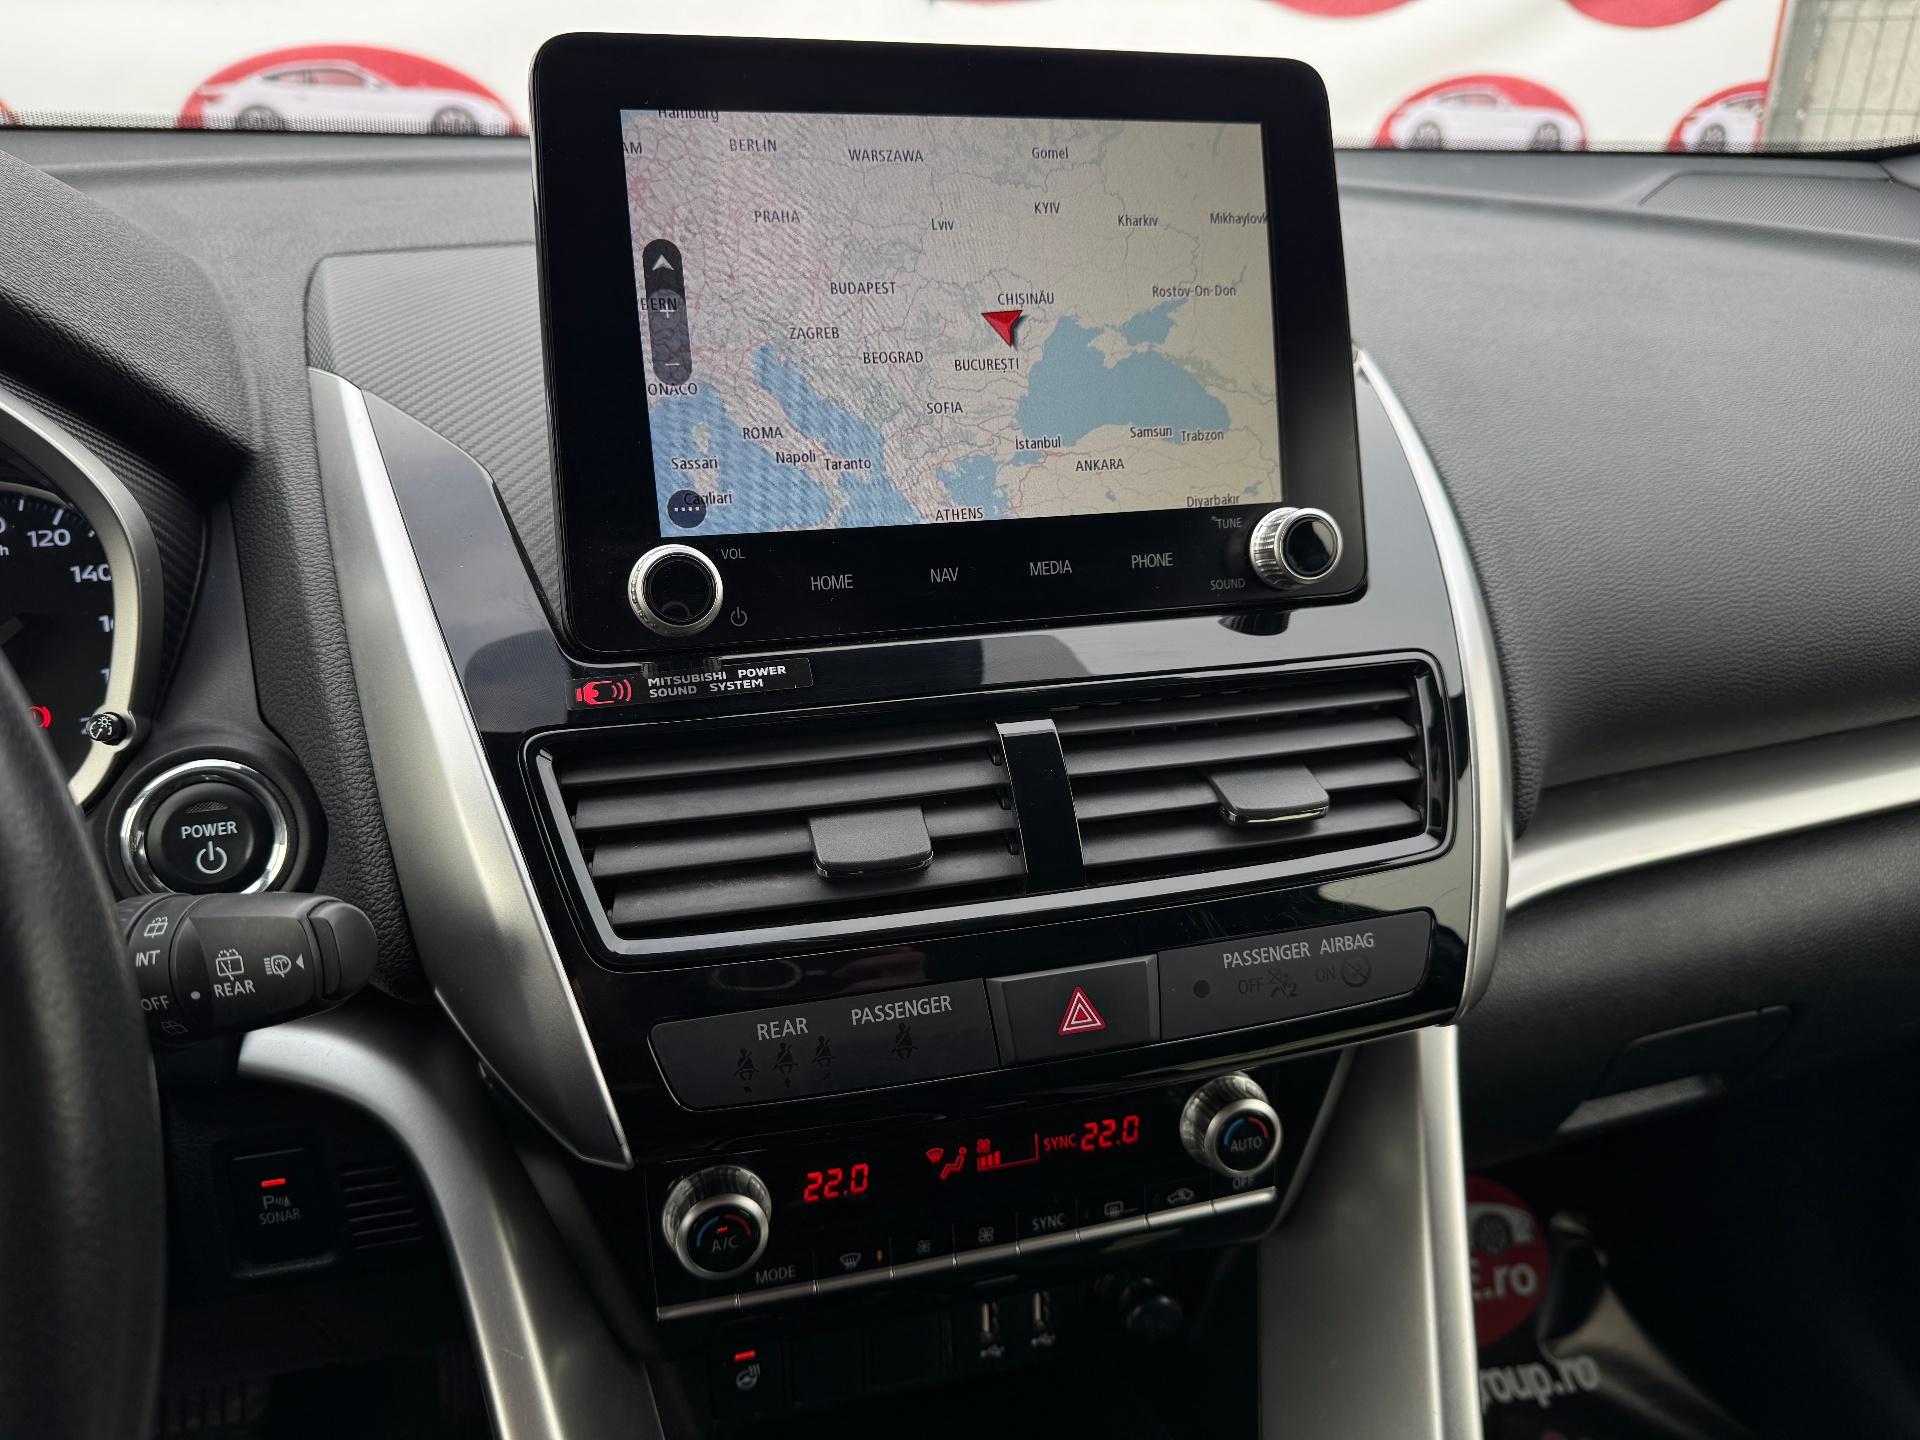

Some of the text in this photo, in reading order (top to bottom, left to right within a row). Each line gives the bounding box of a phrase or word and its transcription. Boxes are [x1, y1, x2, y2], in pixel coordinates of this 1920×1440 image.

[729, 138, 777, 152] BERLIN
[849, 149, 924, 163] WARSZAWA
[1031, 146, 1069, 160] Gomel
[1034, 201, 1060, 215] KYIV
[754, 209, 800, 223] PRAHA
[1117, 214, 1158, 227] Kharkiv
[931, 217, 954, 231] Lviv
[830, 281, 896, 296] BUDAPEST
[1152, 284, 1237, 299] Rostov-On-Don
[640, 297, 677, 311] BERN
[789, 326, 840, 340] ZAGREB
[862, 350, 923, 365] BEOGRAD
[926, 402, 963, 415] SOFIA
[742, 427, 783, 440] ROMA
[1129, 427, 1173, 439] Samsun
[1180, 429, 1225, 442] Trabzon
[671, 456, 719, 470] Sassari
[775, 451, 817, 465] Napoli
[824, 458, 872, 471] Taranto
[1075, 458, 1126, 472] ANKARA
[684, 491, 733, 507] Cagliari
[935, 507, 984, 522] ATHENS
[1215, 517, 1243, 529] TUNE
[27, 528, 72, 549] 120
[721, 548, 746, 560] VOL
[1131, 552, 1174, 569] PHONE
[930, 567, 959, 584] NAV
[1029, 559, 1073, 577] MEDIA
[811, 574, 854, 592] HOME
[1210, 578, 1246, 591] SOUND
[647, 665, 787, 688] MITSUBISHI POWER
[649, 678, 764, 699] SOUND SYSTEM
[181, 820, 238, 840] POWER
[1223, 932, 1375, 968] PASSENGER AIRBAG
[135, 950, 161, 968] INT
[213, 979, 256, 999] REAR
[140, 995, 169, 1012] OFF
[851, 995, 952, 1025] PASSENGER
[756, 1018, 808, 1040] REAR
[1043, 1115, 1140, 1151] SYNC 22.0
[1230, 1135, 1262, 1153] AUTO
[803, 1162, 869, 1204] 22.0
[259, 1208, 300, 1225] SONAR
[1032, 1213, 1064, 1231] SYNC
[711, 1235, 738, 1253] A/C
[755, 1265, 797, 1284] MODE
